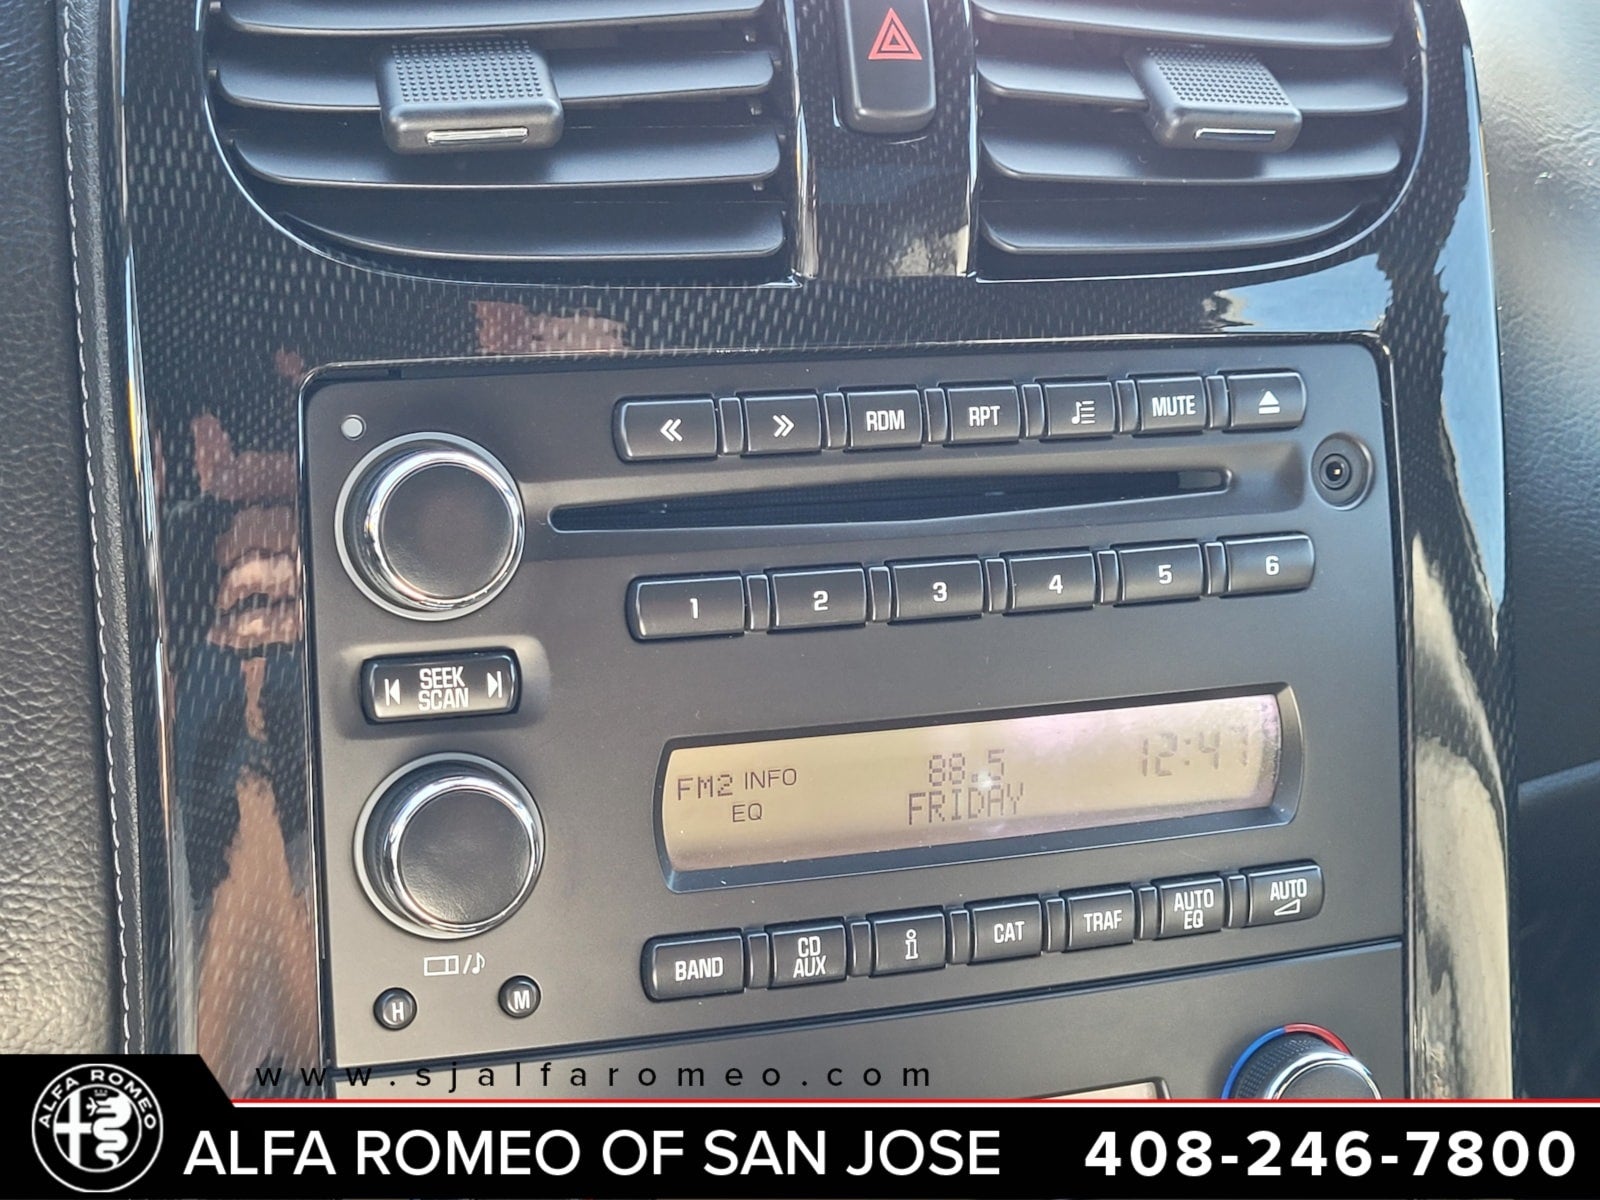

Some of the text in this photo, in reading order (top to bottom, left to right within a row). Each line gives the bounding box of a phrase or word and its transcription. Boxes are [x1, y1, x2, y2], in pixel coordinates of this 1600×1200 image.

[968, 405, 1001, 430] RPT
[1151, 394, 1197, 418] MUTE
[865, 409, 905, 433] RDM
[1158, 563, 1173, 585] 5
[1264, 554, 1280, 577] 6
[932, 581, 949, 603] 3
[1047, 574, 1065, 596] 4
[689, 596, 700, 621] 1
[812, 590, 830, 613] 2
[419, 667, 466, 690] SEEK
[417, 688, 470, 713] SCAN
[928, 750, 1005, 788] 88.5
[677, 767, 798, 801] FM2 INFO
[732, 802, 763, 823] EQ
[908, 781, 1025, 826] FRIDAY
[1173, 889, 1215, 913] AUTO
[1269, 877, 1309, 902] AUTO
[1083, 908, 1123, 933] TRAF
[1183, 909, 1204, 931] EQ
[992, 921, 1026, 945] CAT
[796, 936, 821, 958] CD
[674, 956, 724, 983] BAND
[793, 955, 827, 980] AUX
[391, 1001, 405, 1021] H
[513, 990, 530, 1009] M
